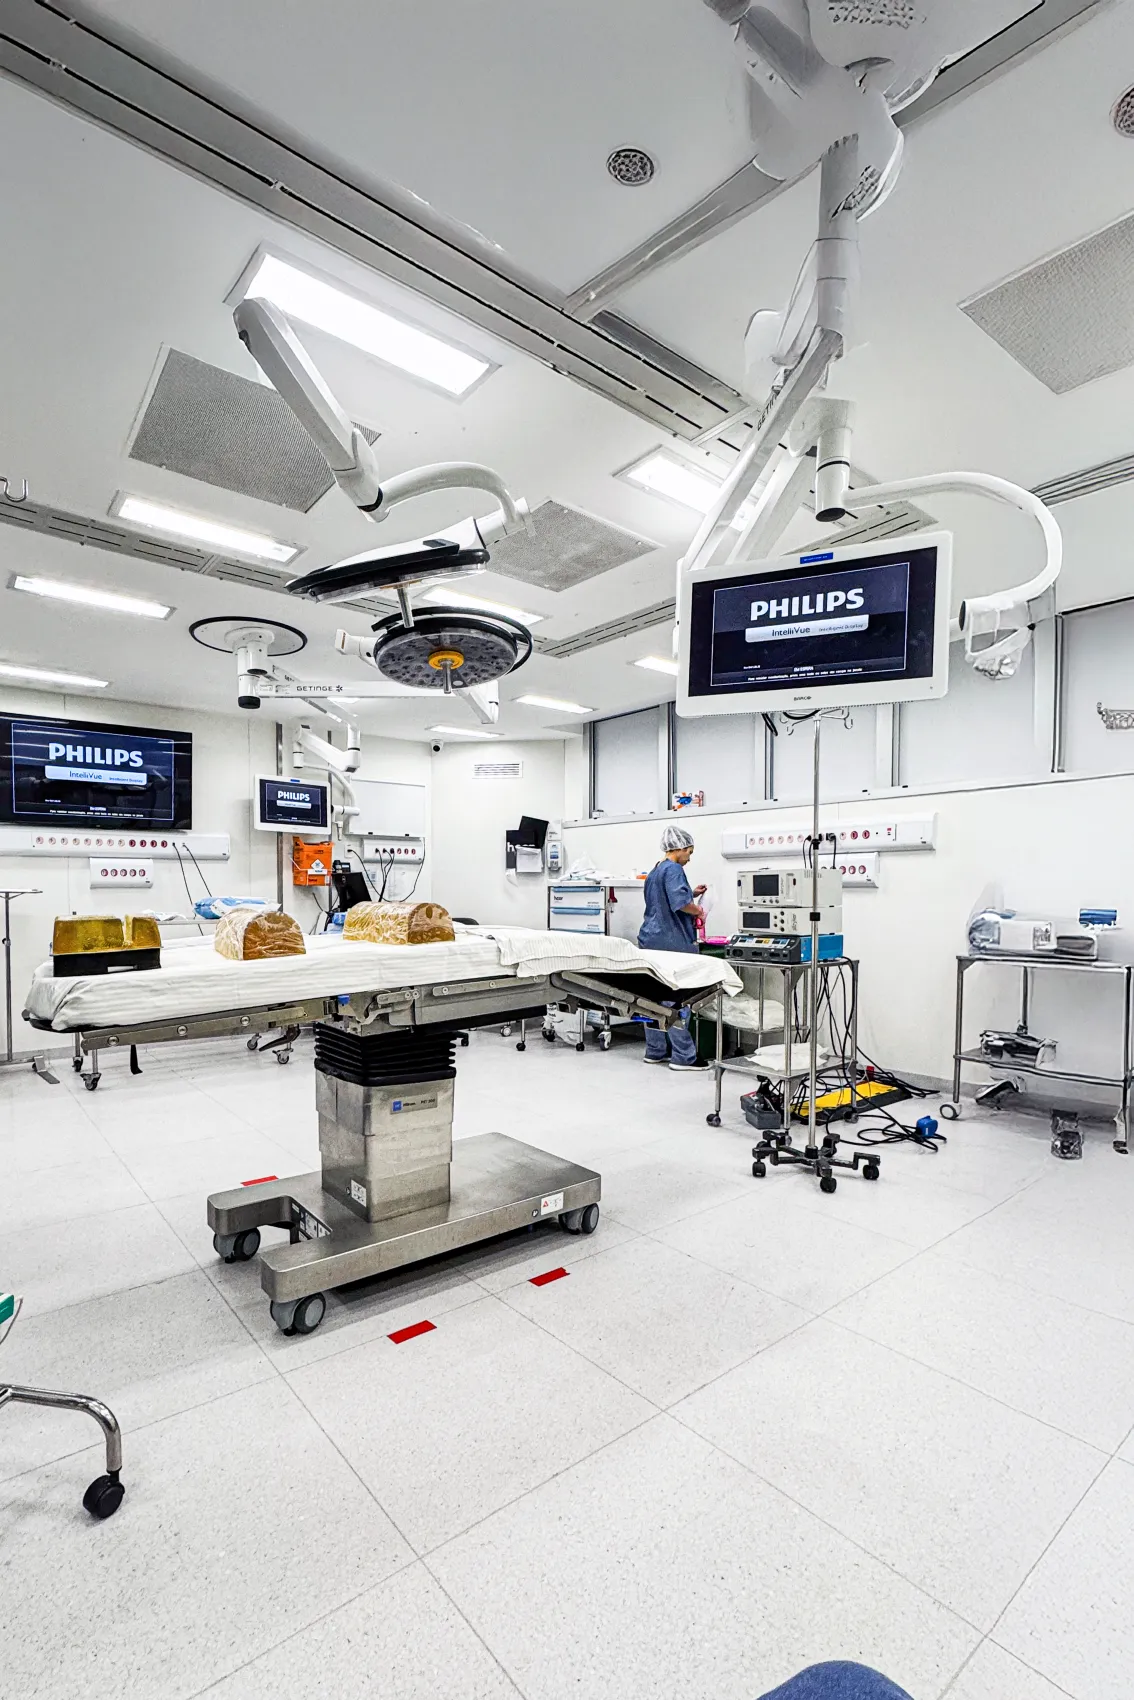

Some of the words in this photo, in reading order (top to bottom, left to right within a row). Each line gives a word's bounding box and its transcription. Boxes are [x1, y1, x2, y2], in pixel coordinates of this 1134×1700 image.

[750, 588, 864, 621] PHILIPS
[772, 626, 810, 637] IntelliVue
[49, 743, 143, 767] PHILIPS
[69, 771, 102, 780] IntelliVue
[278, 791, 310, 801] PHILIPS
